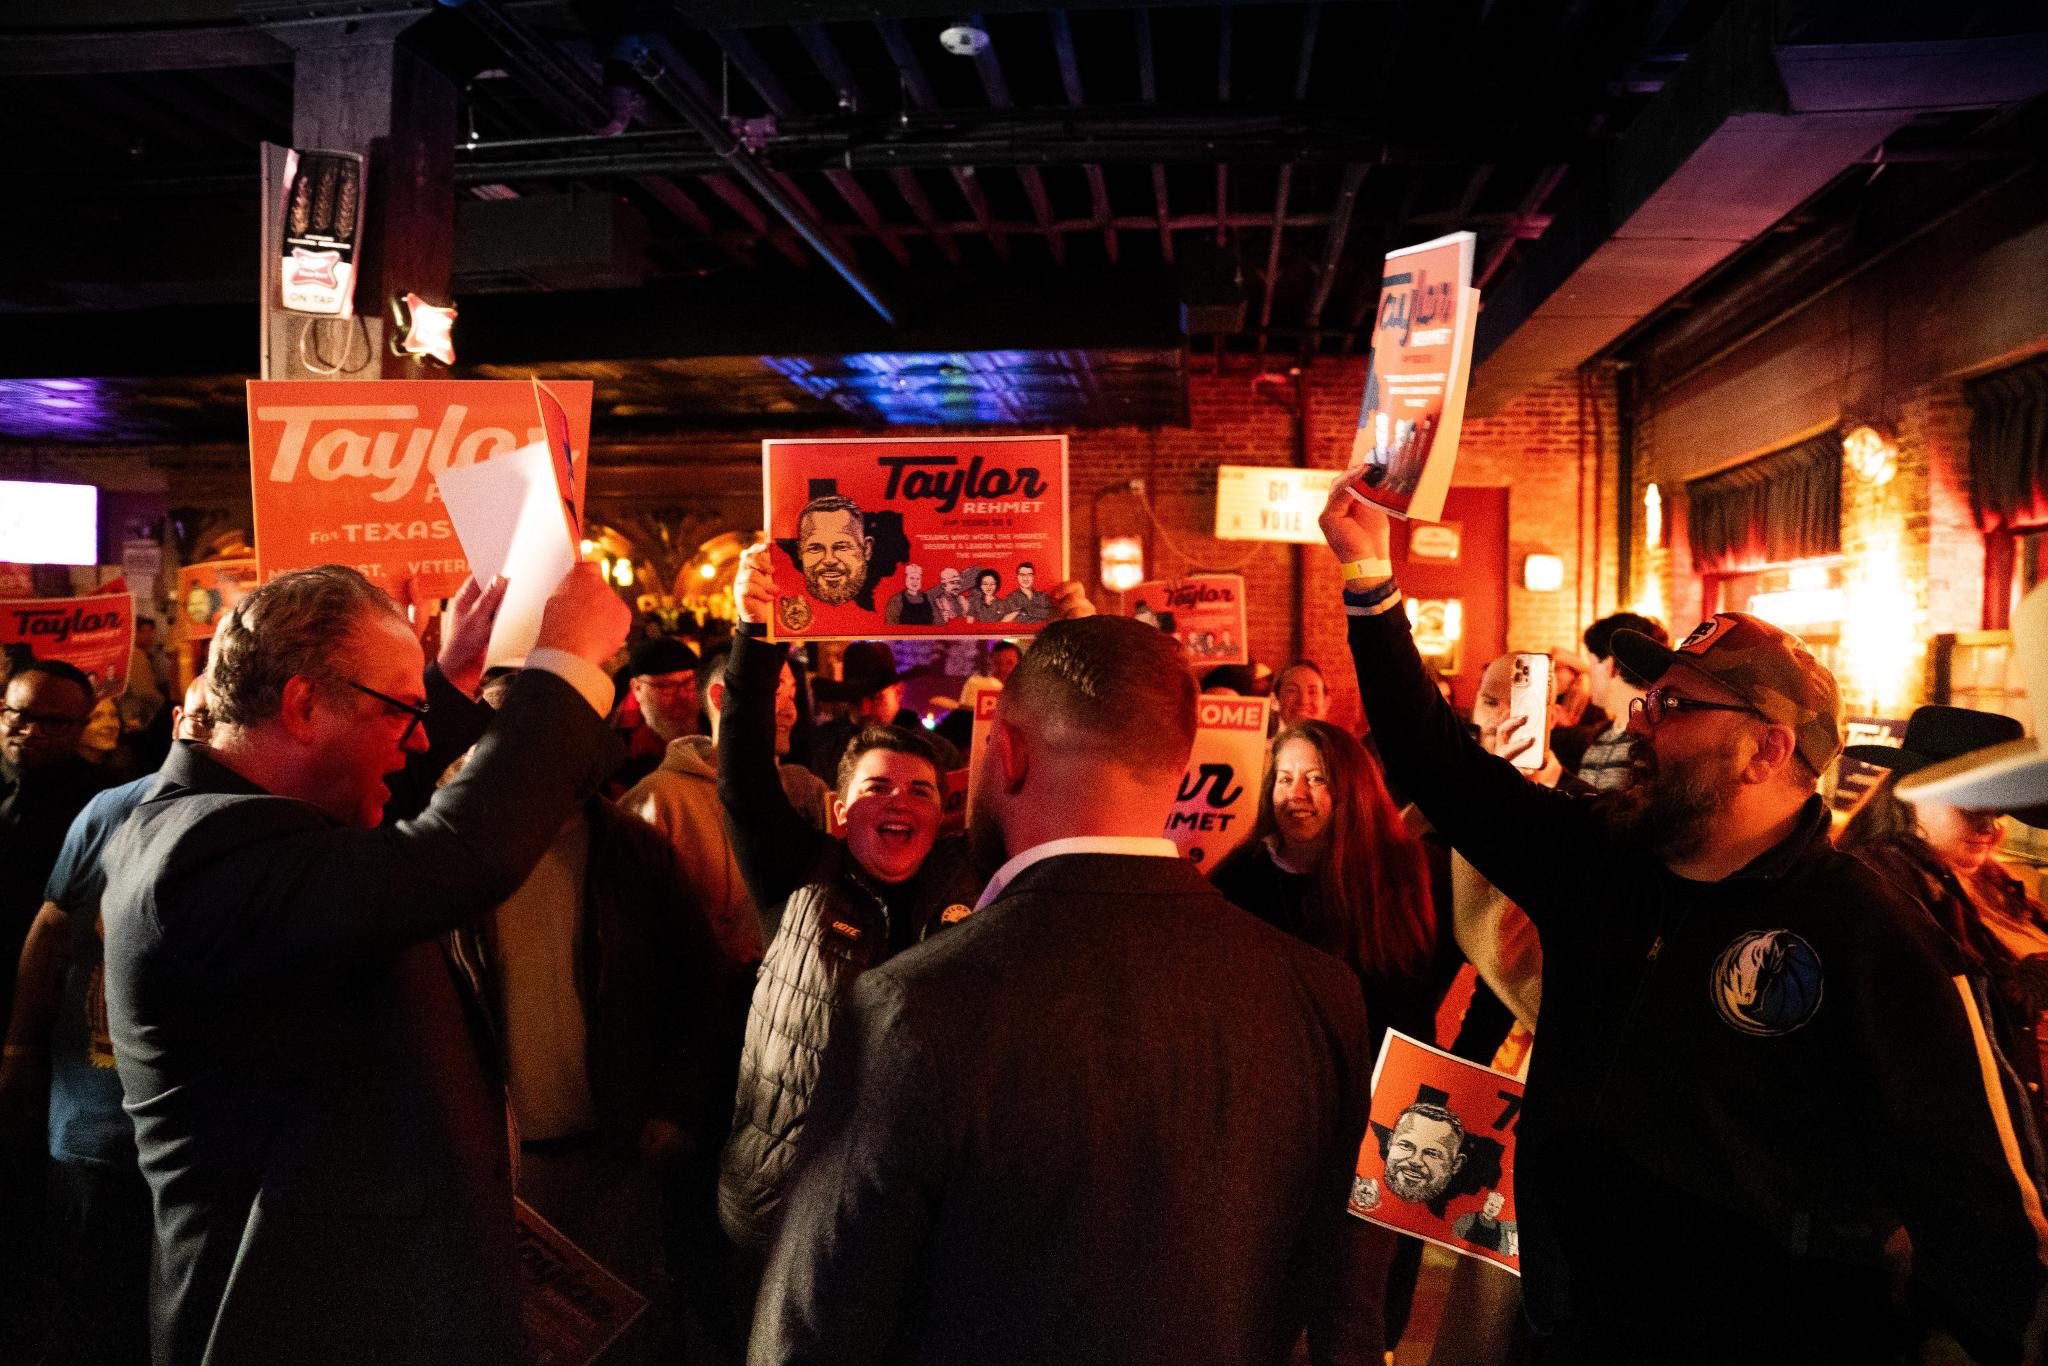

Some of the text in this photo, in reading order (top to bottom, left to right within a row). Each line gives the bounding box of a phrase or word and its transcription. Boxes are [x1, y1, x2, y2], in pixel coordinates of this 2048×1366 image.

[878, 456, 1048, 513] Taylor
[1268, 480, 1289, 502] GO
[962, 501, 1044, 515] REHMET
[309, 519, 451, 545] For TEXAS
[1163, 584, 1234, 609] Taylor
[12, 607, 121, 642] Taylor
[1201, 703, 1261, 727] OME
[1165, 811, 1235, 832] MET
